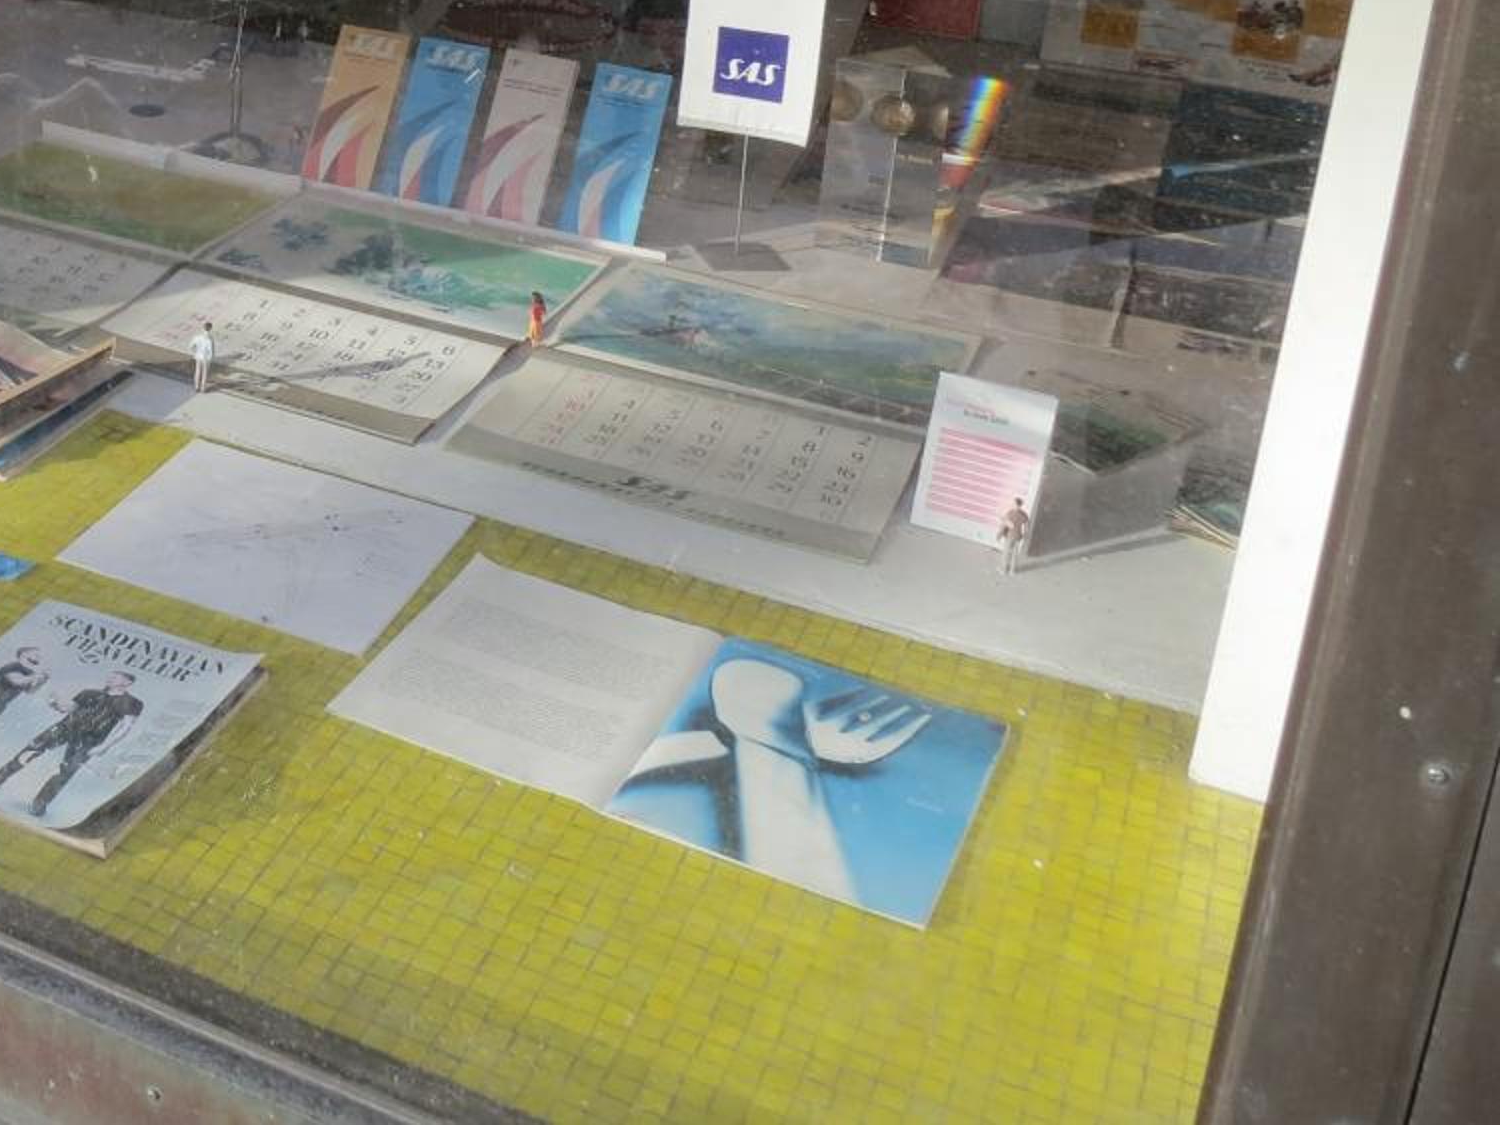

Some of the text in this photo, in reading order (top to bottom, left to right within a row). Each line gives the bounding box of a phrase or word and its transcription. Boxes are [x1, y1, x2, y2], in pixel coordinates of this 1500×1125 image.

[719, 58, 783, 86] SAS
[50, 615, 225, 674] SCANDINAVIAN
[63, 633, 199, 682] TRAVELLER
